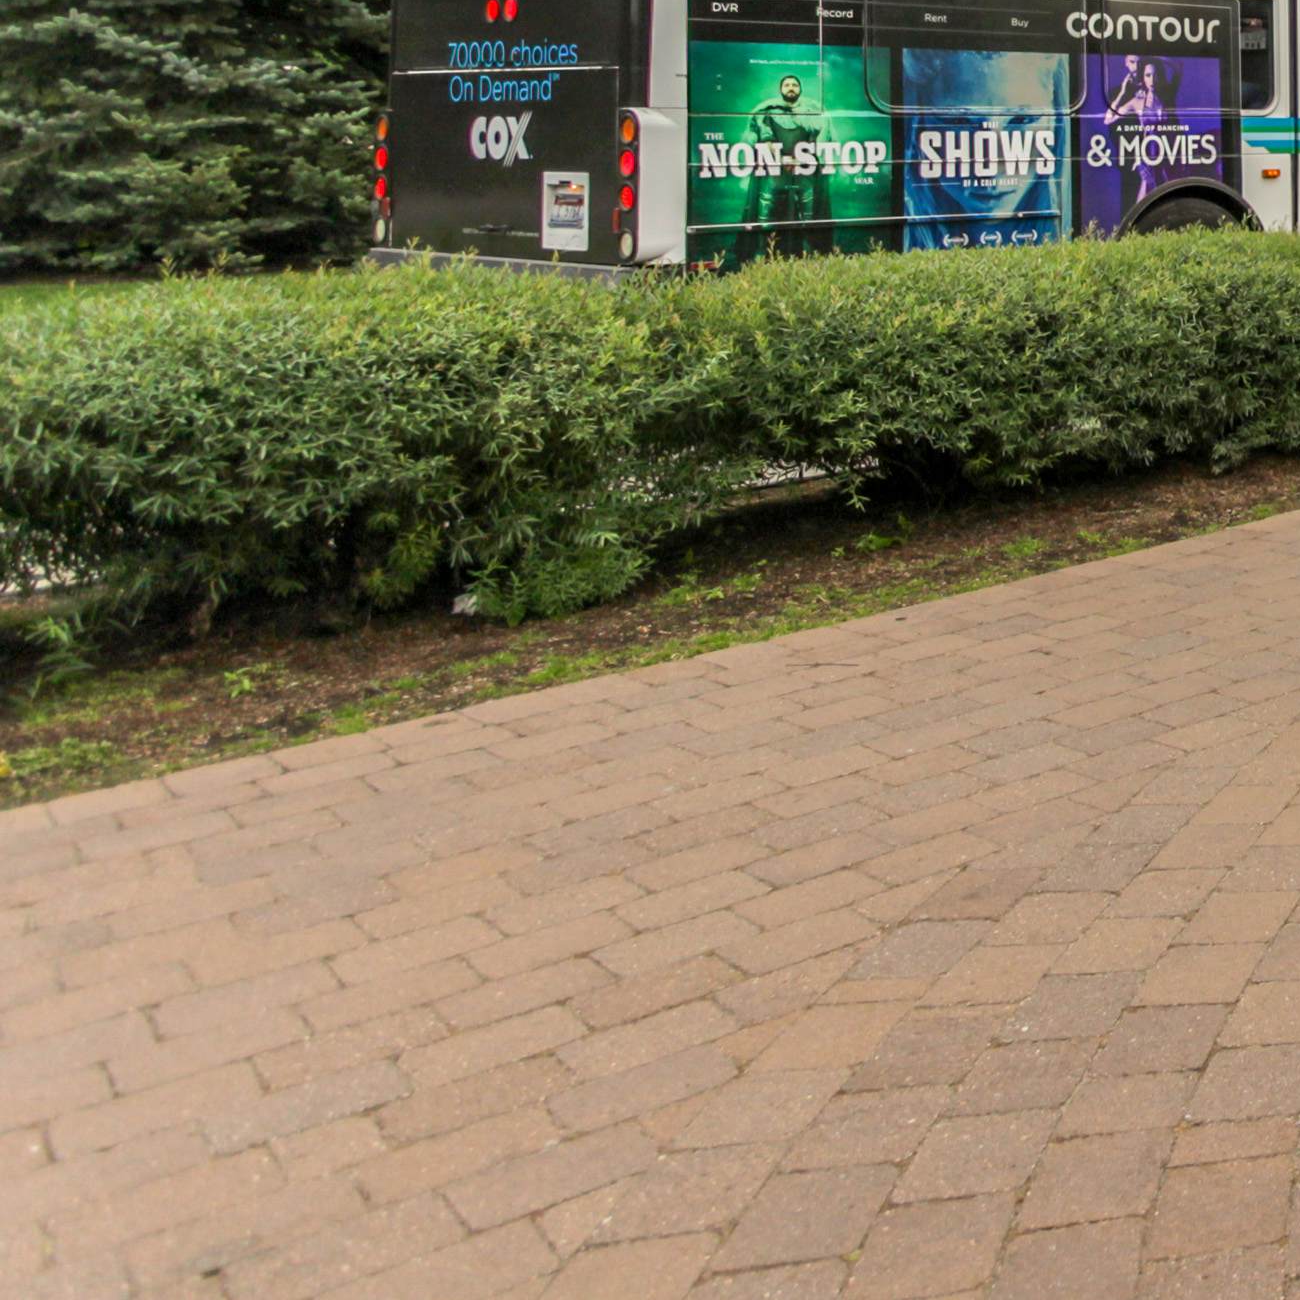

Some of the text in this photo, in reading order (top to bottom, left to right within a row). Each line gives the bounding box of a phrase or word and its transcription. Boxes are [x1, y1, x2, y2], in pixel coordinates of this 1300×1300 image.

[711, 1, 740, 14] DVR
[815, 6, 855, 19] Record
[924, 12, 948, 24] Rent
[1010, 16, 1030, 29] Buy
[510, 37, 579, 67] choices
[450, 75, 474, 102] On
[470, 110, 534, 168] COX
[703, 132, 725, 141] THE
[698, 140, 888, 179] NON-STOP
[919, 130, 1056, 179] SHOWS
[1086, 133, 1218, 171] & MOVIES
[853, 177, 875, 185] WAR
